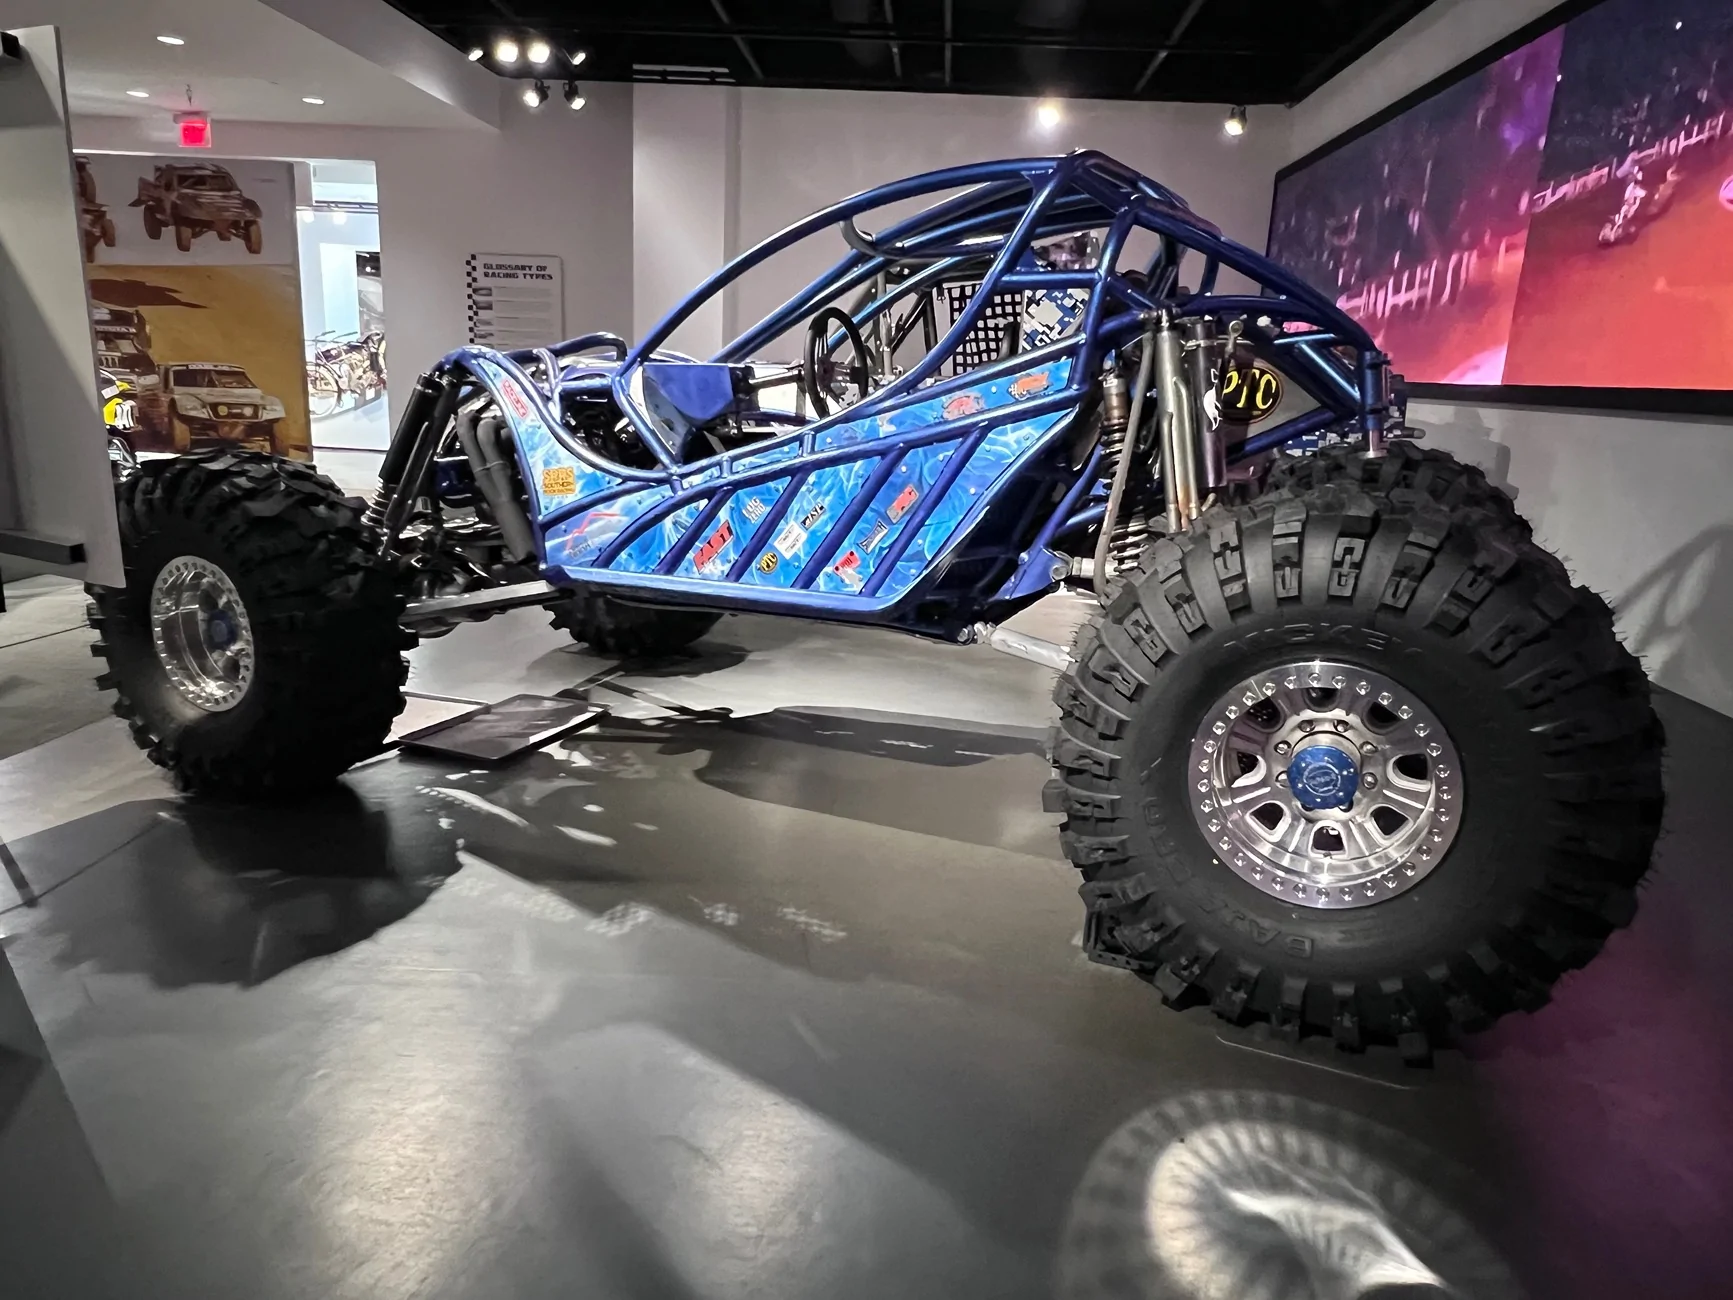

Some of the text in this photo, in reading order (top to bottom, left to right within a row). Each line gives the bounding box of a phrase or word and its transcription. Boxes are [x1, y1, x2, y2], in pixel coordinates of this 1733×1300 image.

[483, 263, 533, 272] GLOSSARY
[483, 271, 553, 280] RACING TYPES
